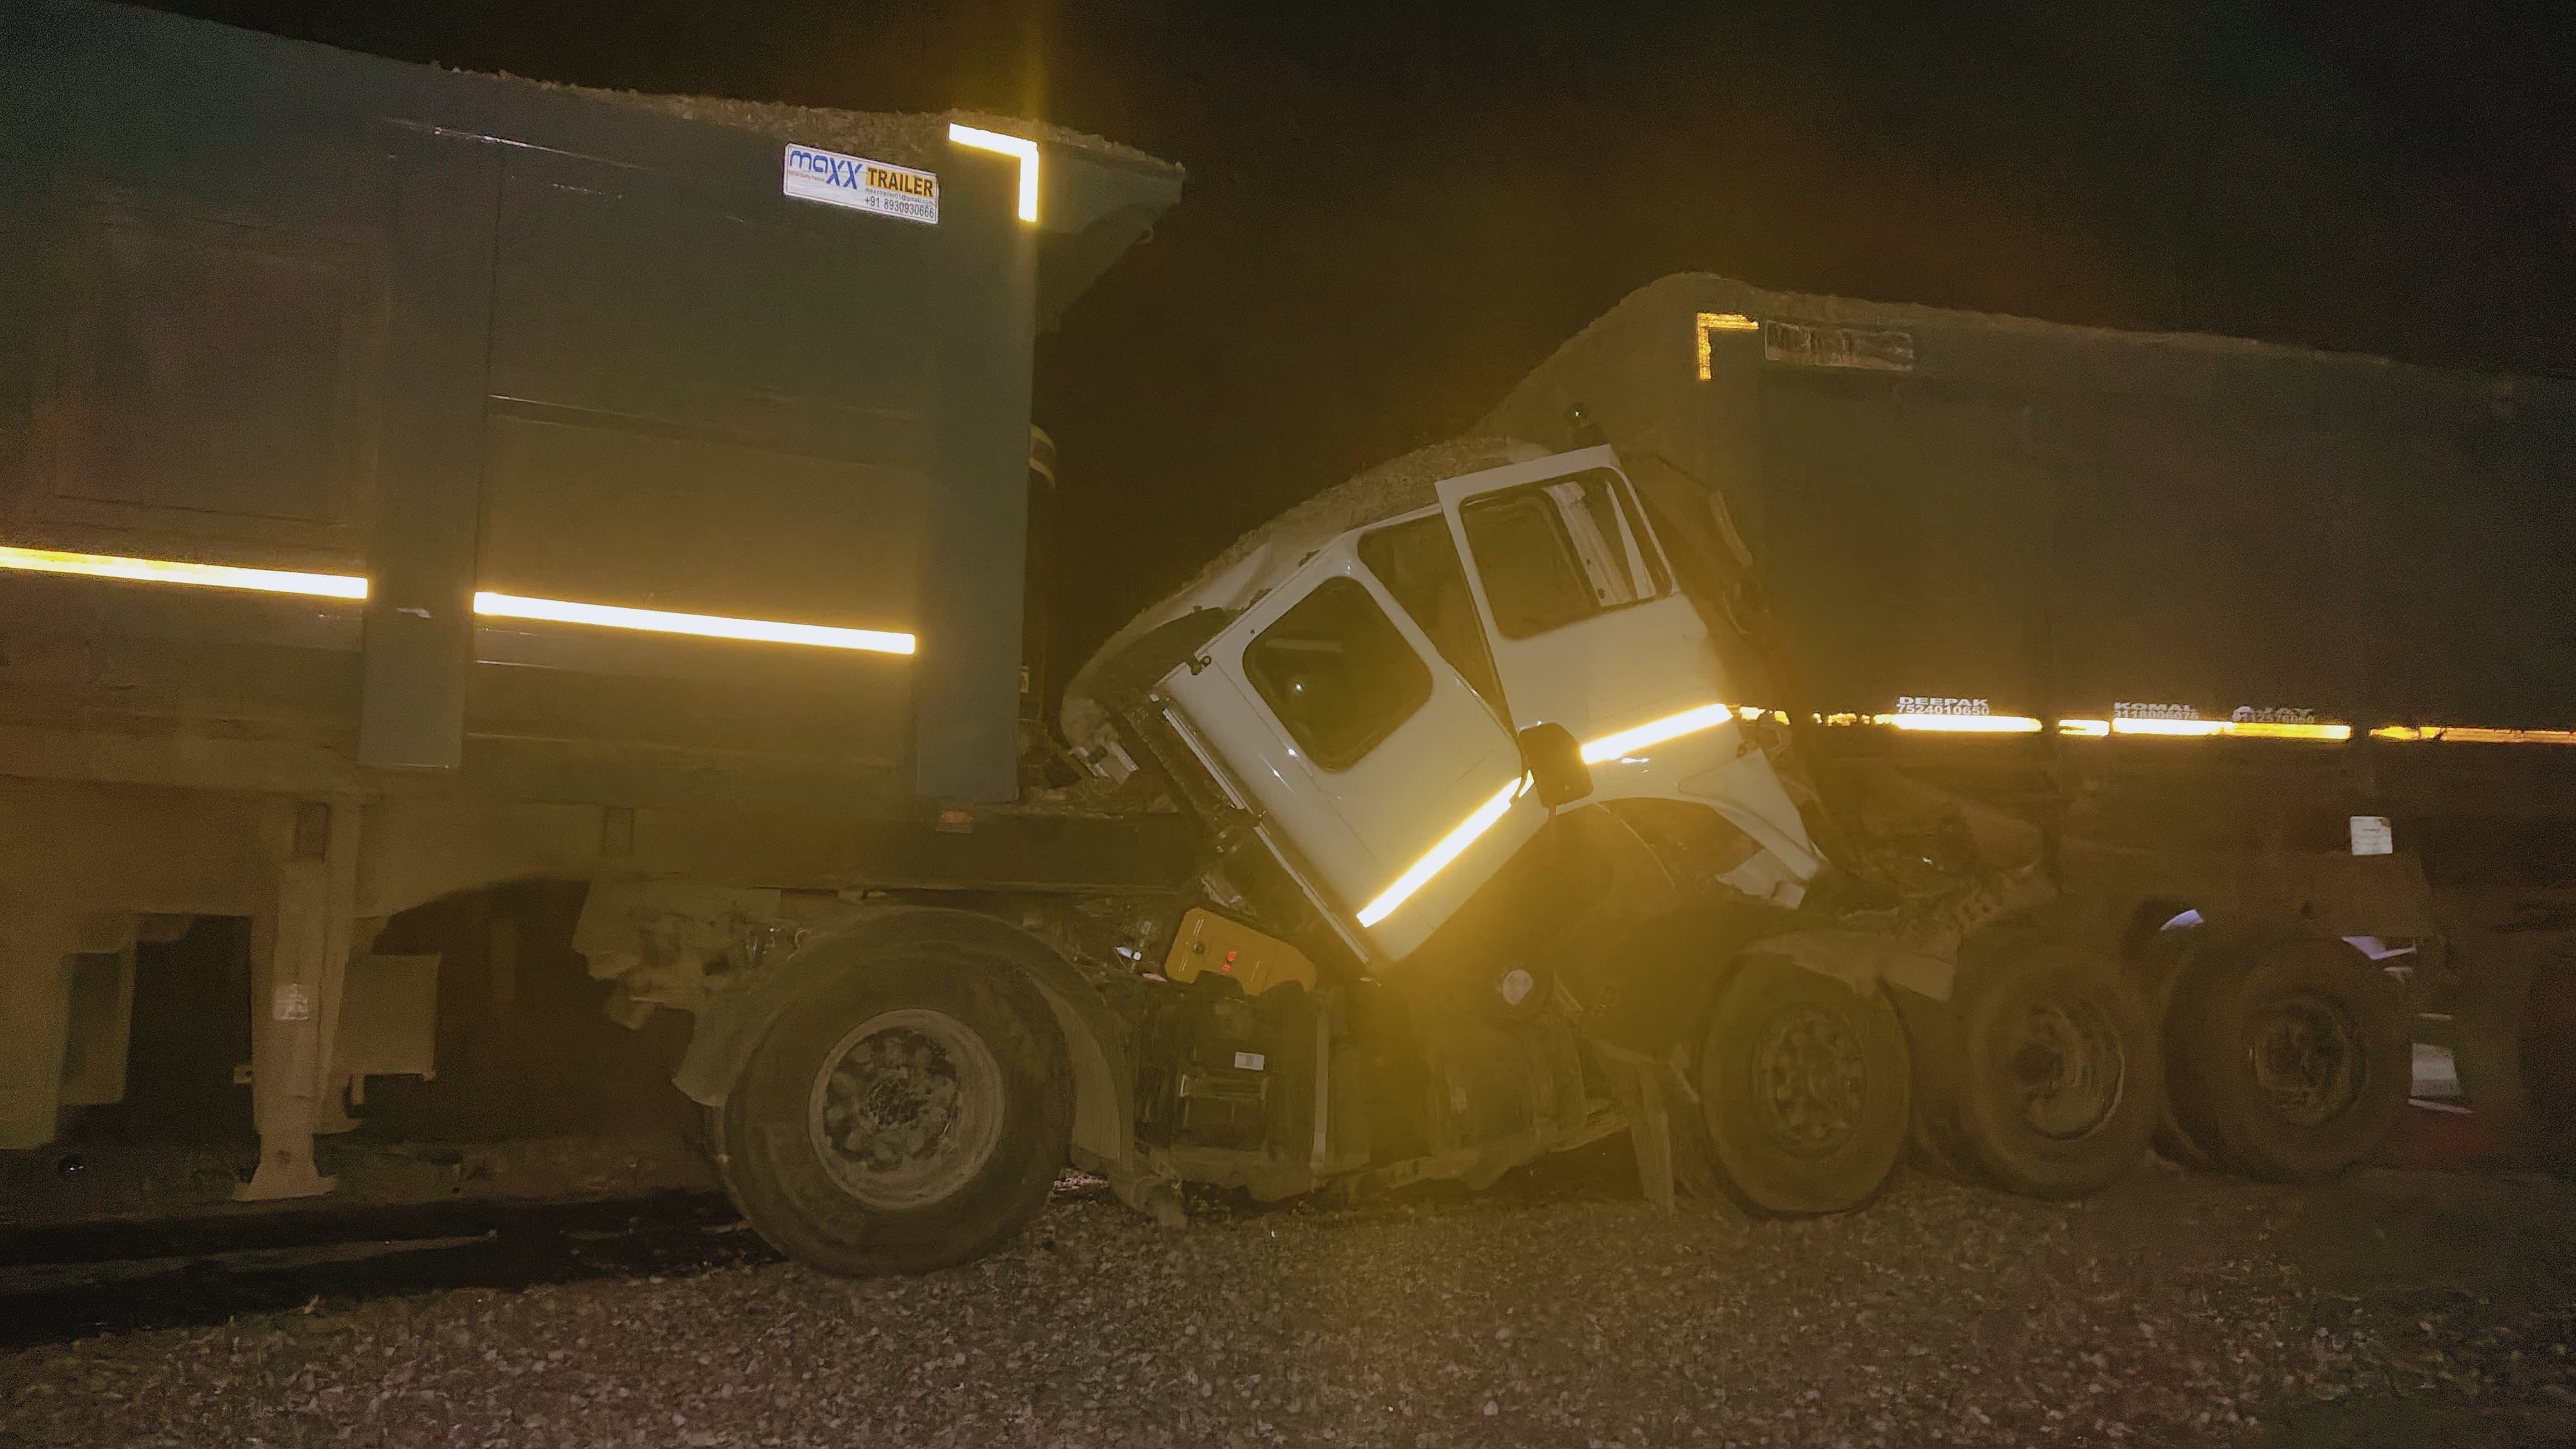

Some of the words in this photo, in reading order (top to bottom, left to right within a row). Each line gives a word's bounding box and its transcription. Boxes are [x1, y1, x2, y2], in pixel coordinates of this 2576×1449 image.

[867, 166, 934, 197] TRAILER
[865, 196, 880, 208] +91
[884, 198, 935, 219] 8930930666
[1896, 704, 1990, 715] 7524010650
[1899, 696, 1988, 706] DEEPAK
